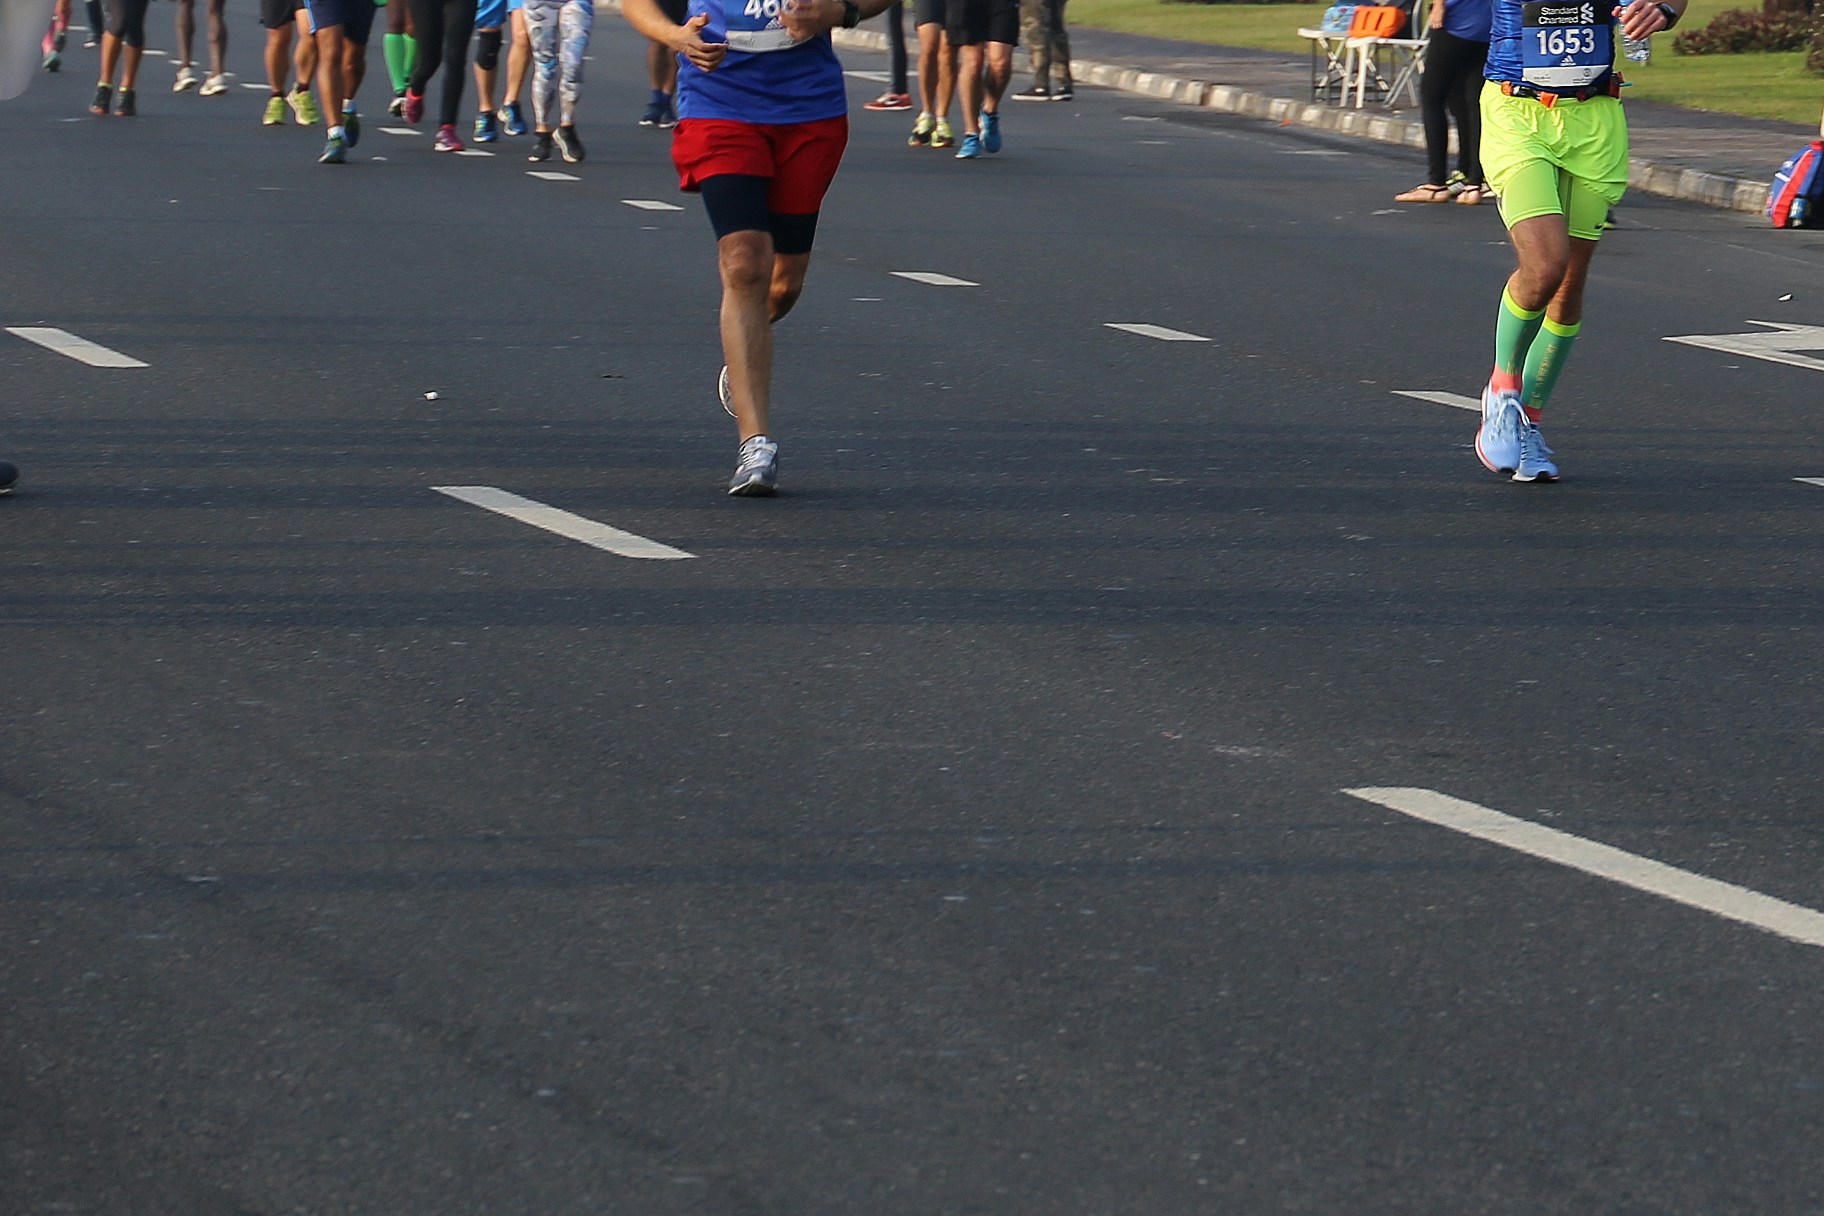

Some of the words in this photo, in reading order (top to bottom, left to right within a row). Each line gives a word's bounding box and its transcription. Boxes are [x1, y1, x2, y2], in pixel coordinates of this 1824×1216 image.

[1540, 6, 1579, 16] Standard
[1537, 16, 1579, 25] Chartered
[1536, 28, 1595, 55] 1653
